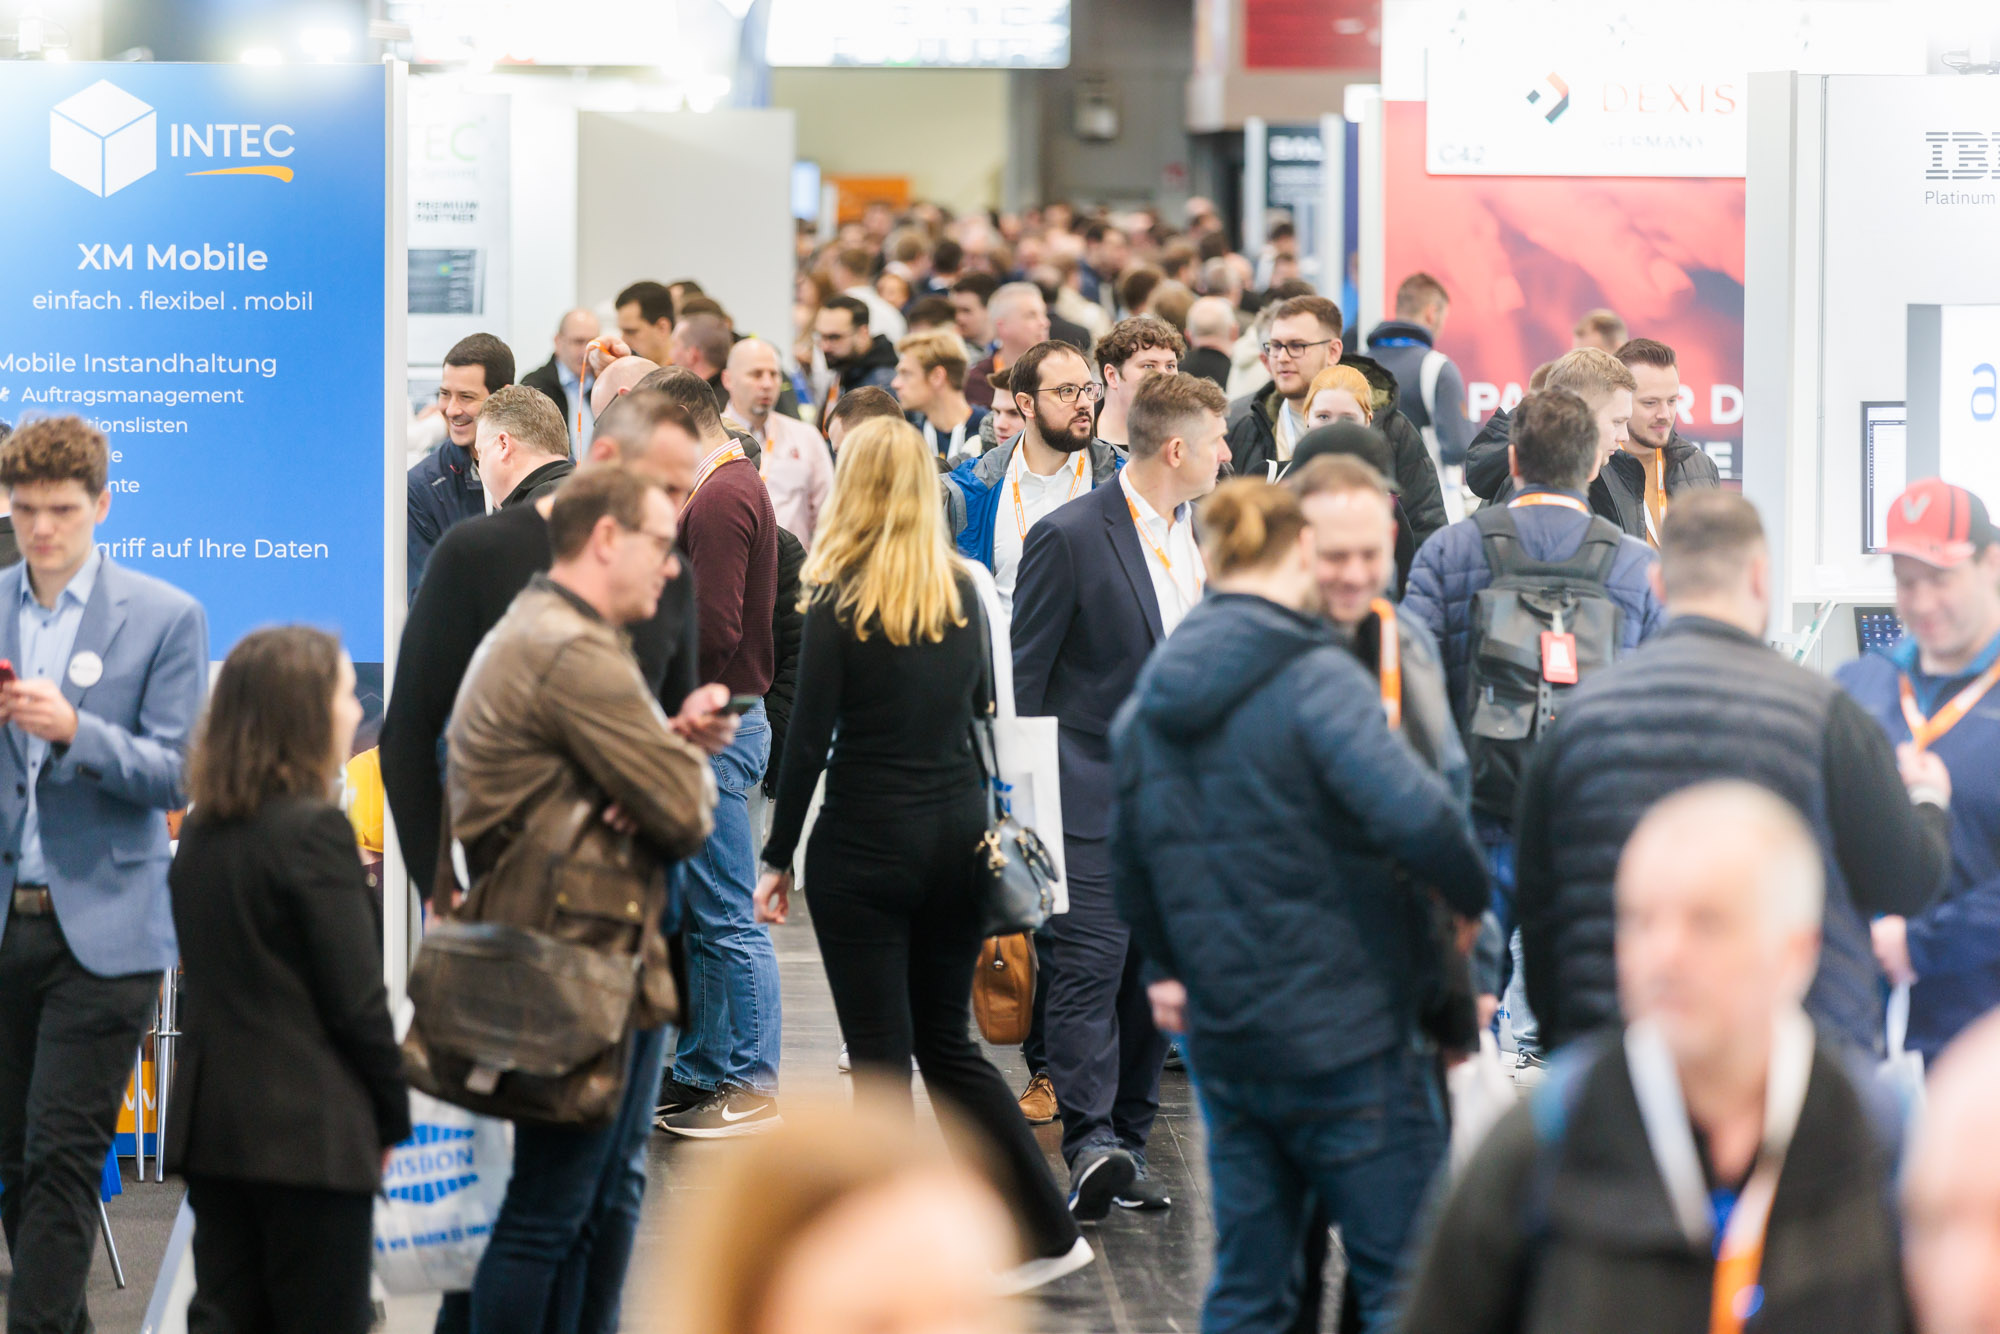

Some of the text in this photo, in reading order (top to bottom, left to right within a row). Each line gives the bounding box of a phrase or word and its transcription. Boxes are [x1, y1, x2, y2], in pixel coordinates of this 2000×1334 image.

[1602, 82, 1736, 115] DEXIS
[170, 123, 296, 158] INTEC
[1438, 144, 1486, 165] C42
[1925, 131, 2000, 180] IB
[1925, 190, 1996, 205] Platinum
[77, 242, 268, 271] XM Mobile
[32, 290, 121, 310] einfach
[140, 290, 224, 310] flexibel
[244, 290, 312, 310] mobil
[84, 353, 277, 378] Instandhaltung
[21, 387, 245, 406] Auftragsmanagement
[152, 538, 192, 558] auf
[199, 538, 246, 558] Ihre
[254, 538, 329, 558] Daten
